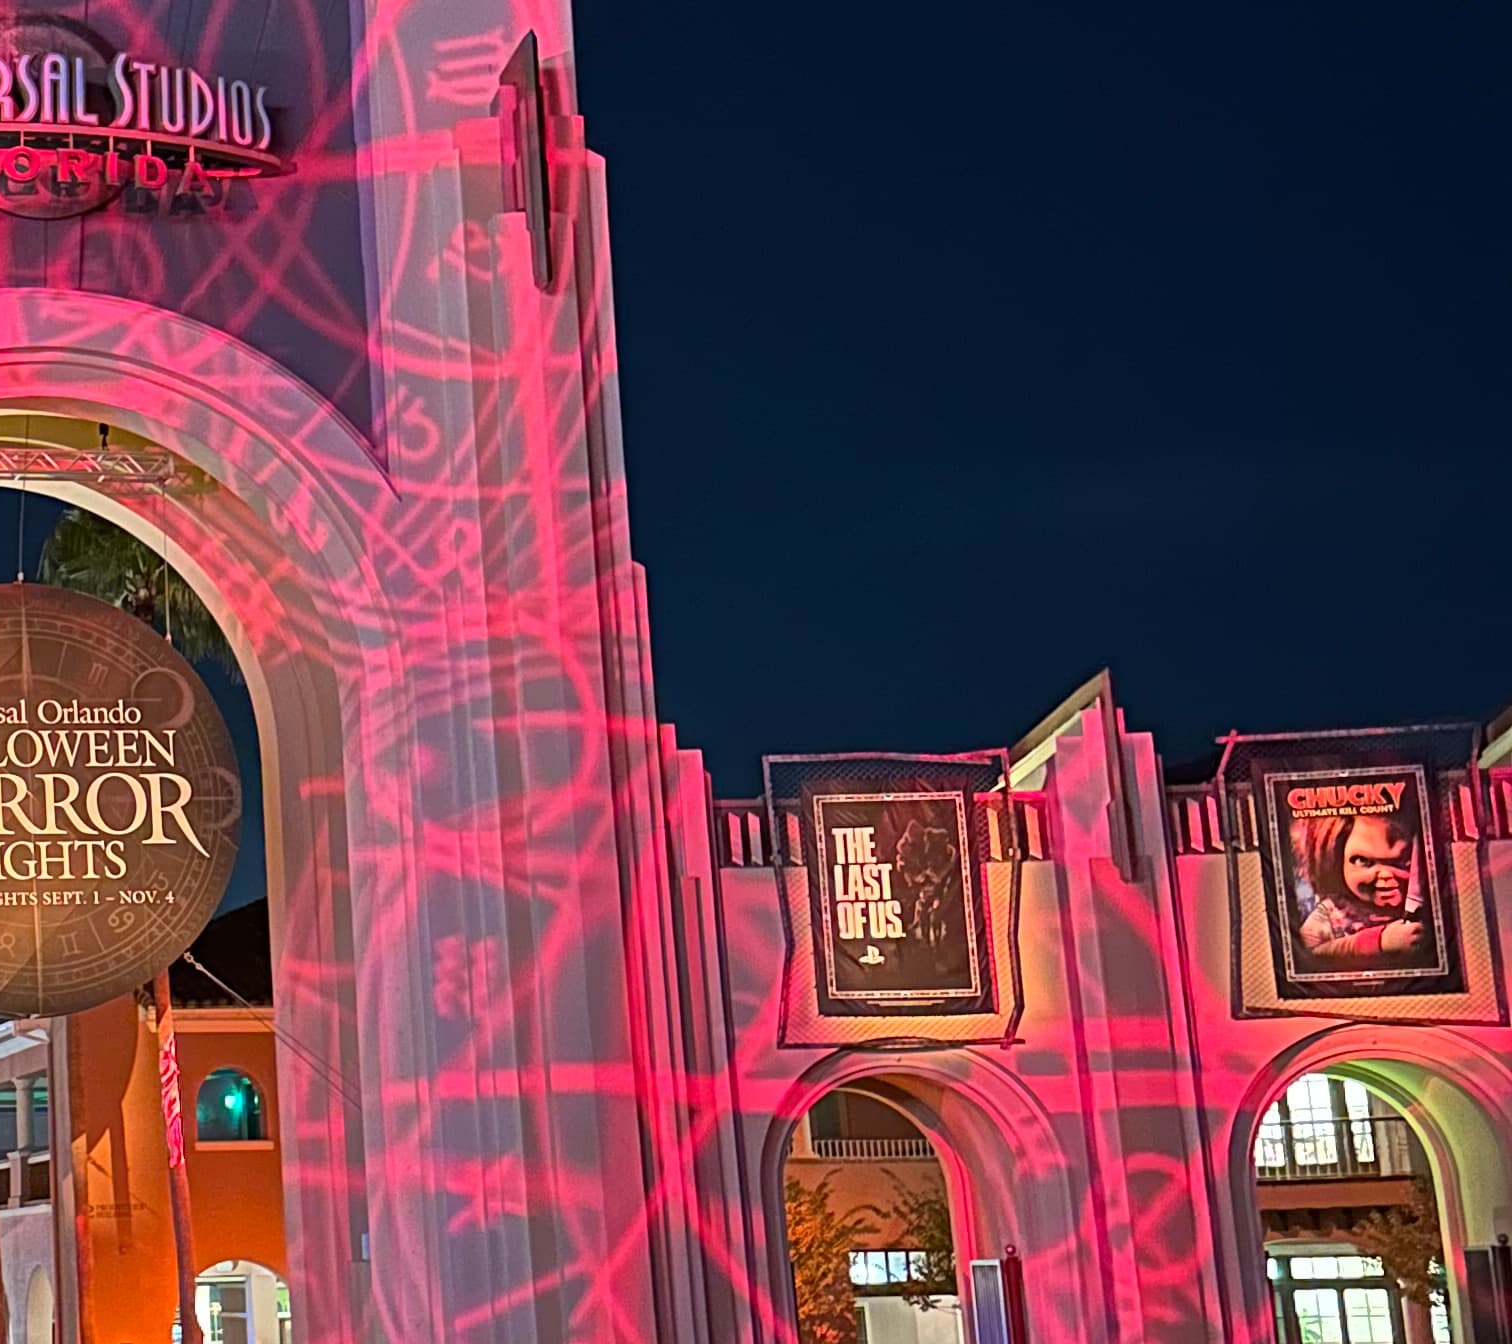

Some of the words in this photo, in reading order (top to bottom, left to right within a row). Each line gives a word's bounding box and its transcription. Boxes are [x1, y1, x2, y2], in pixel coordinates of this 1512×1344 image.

[106, 52, 272, 149] STUDIOS
[37, 699, 142, 725] Orlando
[1287, 781, 1406, 810] CHUCKY
[1339, 806, 1357, 816] KILL
[1360, 804, 1394, 814] COUNT
[831, 826, 877, 865] THE
[41, 890, 88, 906] SEPT.
[93, 890, 100, 905] 1
[119, 889, 161, 905] NOV.
[164, 889, 176, 904] 4
[834, 863, 893, 902] LAST
[836, 901, 867, 940] OF
